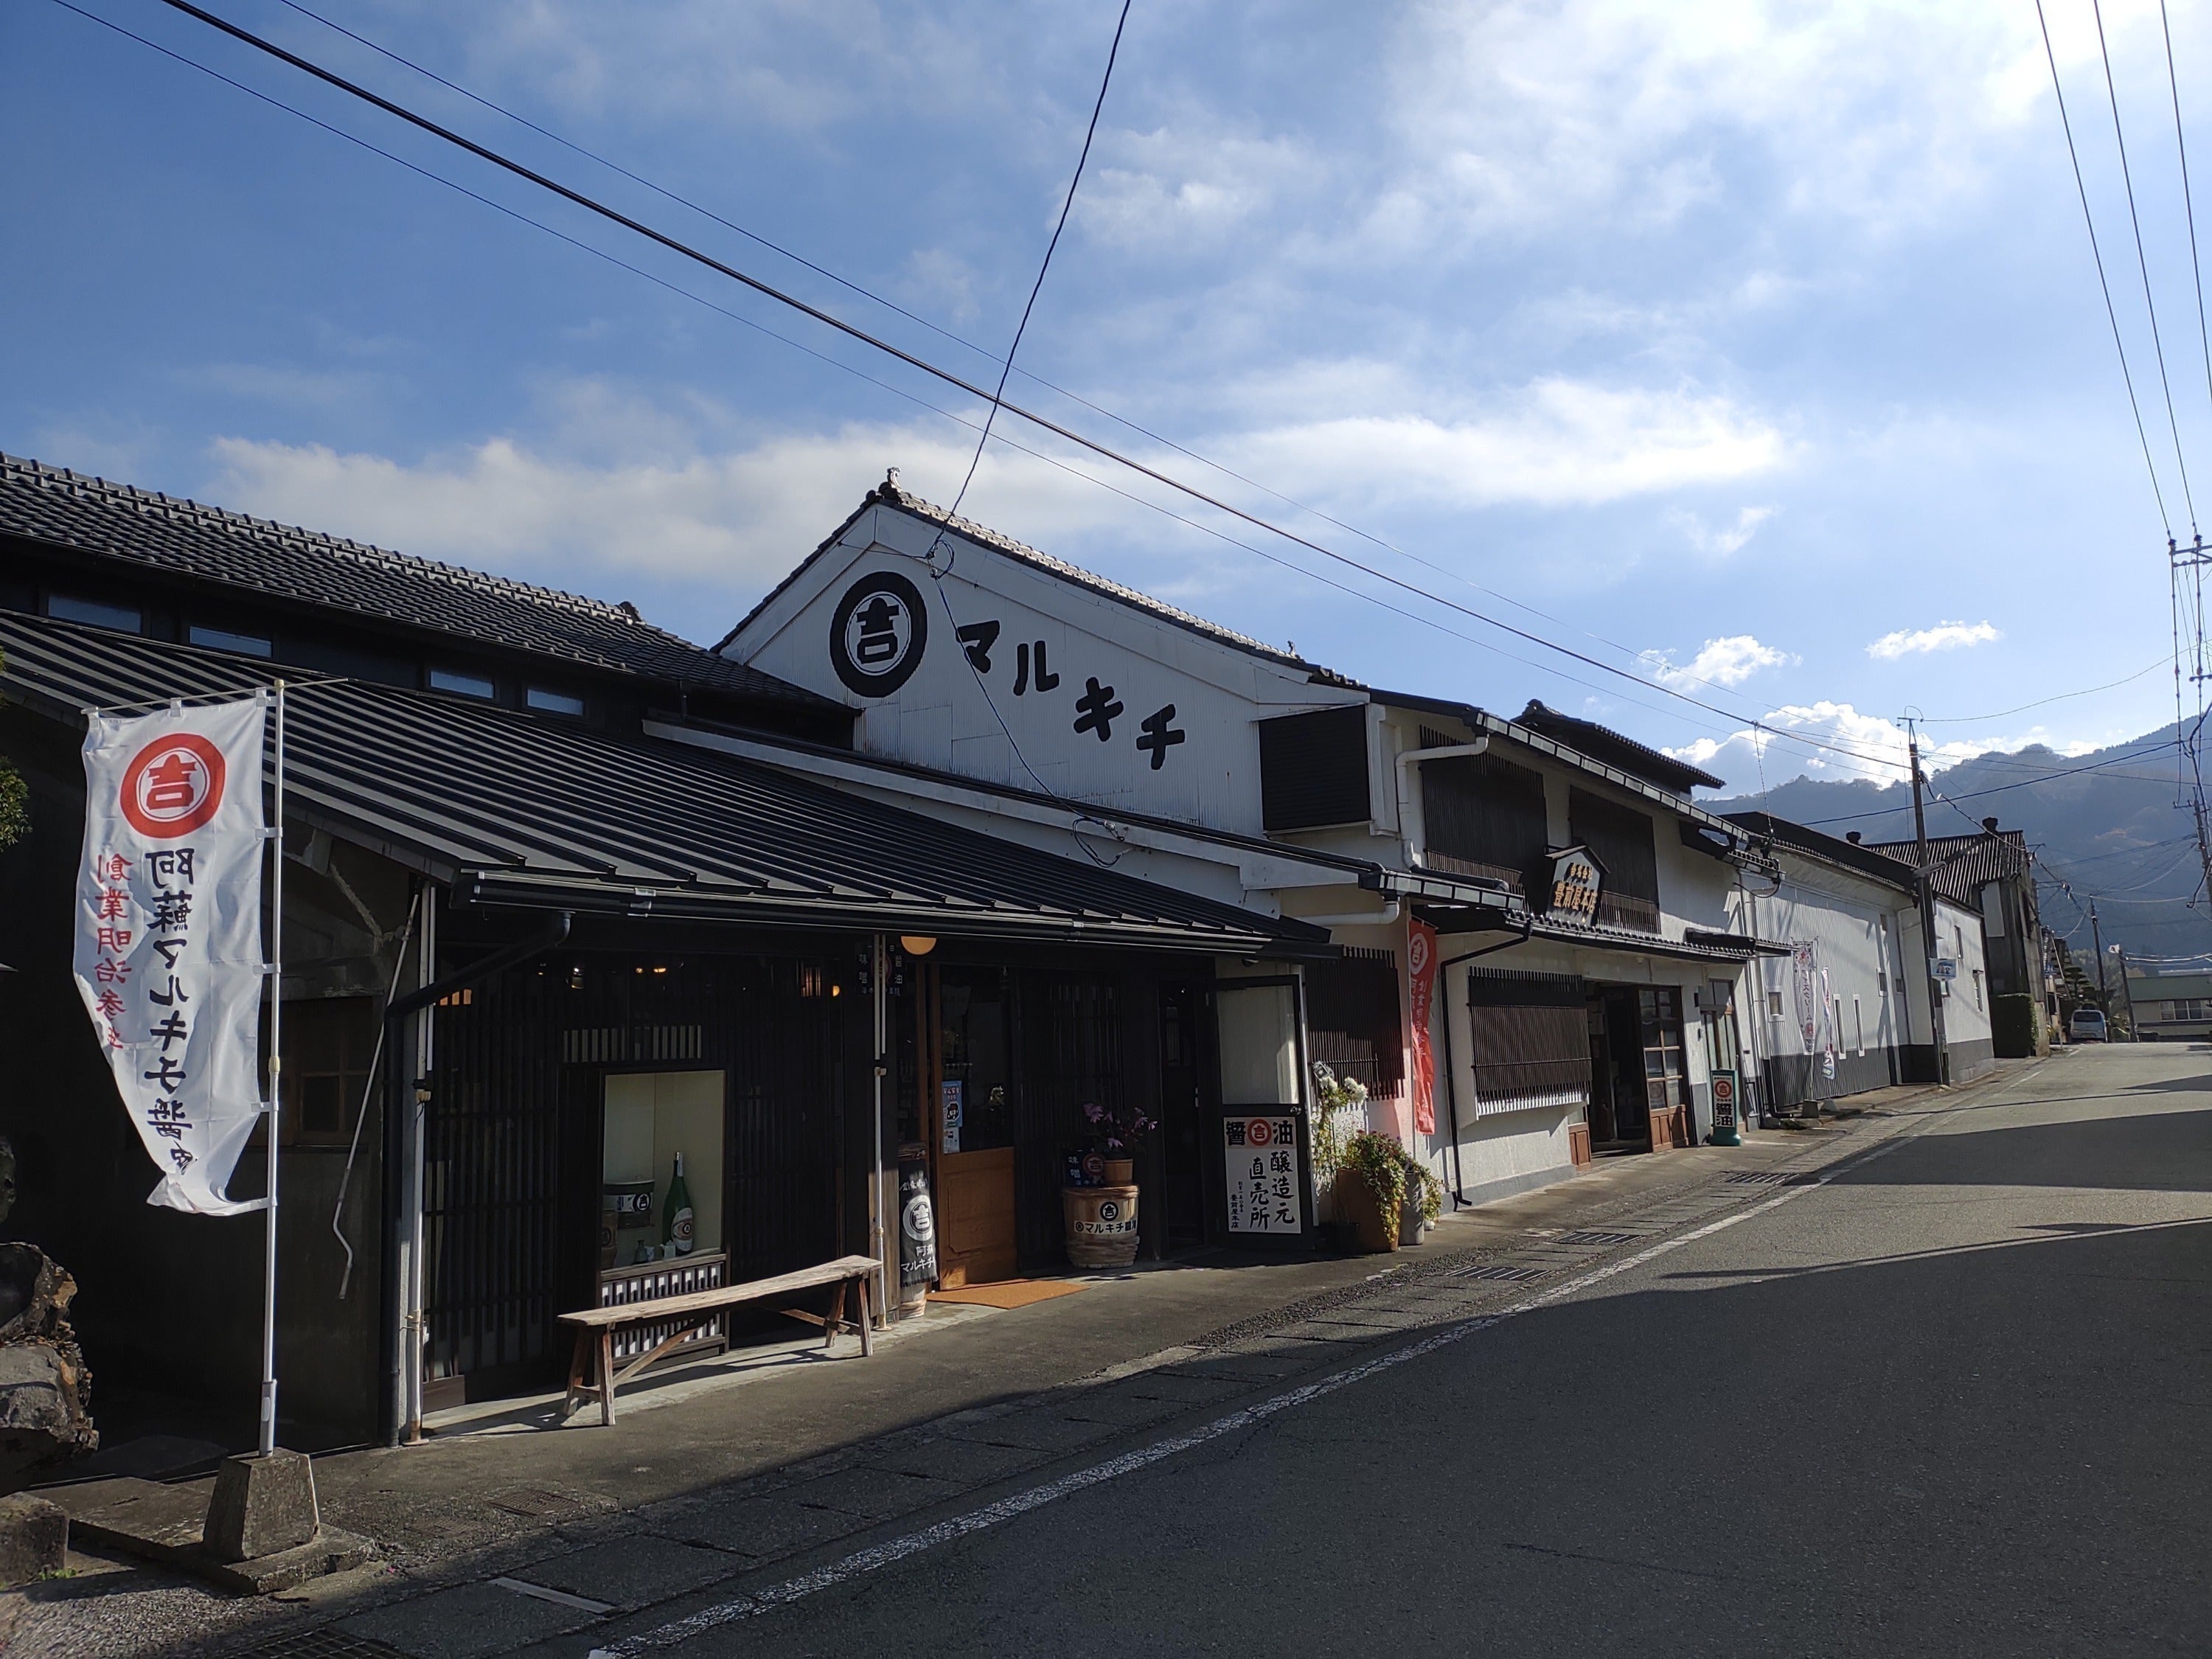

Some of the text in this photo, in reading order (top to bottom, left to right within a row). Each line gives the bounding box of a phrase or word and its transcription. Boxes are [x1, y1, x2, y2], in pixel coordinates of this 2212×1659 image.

[856, 597, 900, 664] 吉
[955, 620, 1186, 771] マルキチ
[1249, 1156, 1270, 1231] 直売所
[1270, 1150, 1295, 1224] 醸造元
